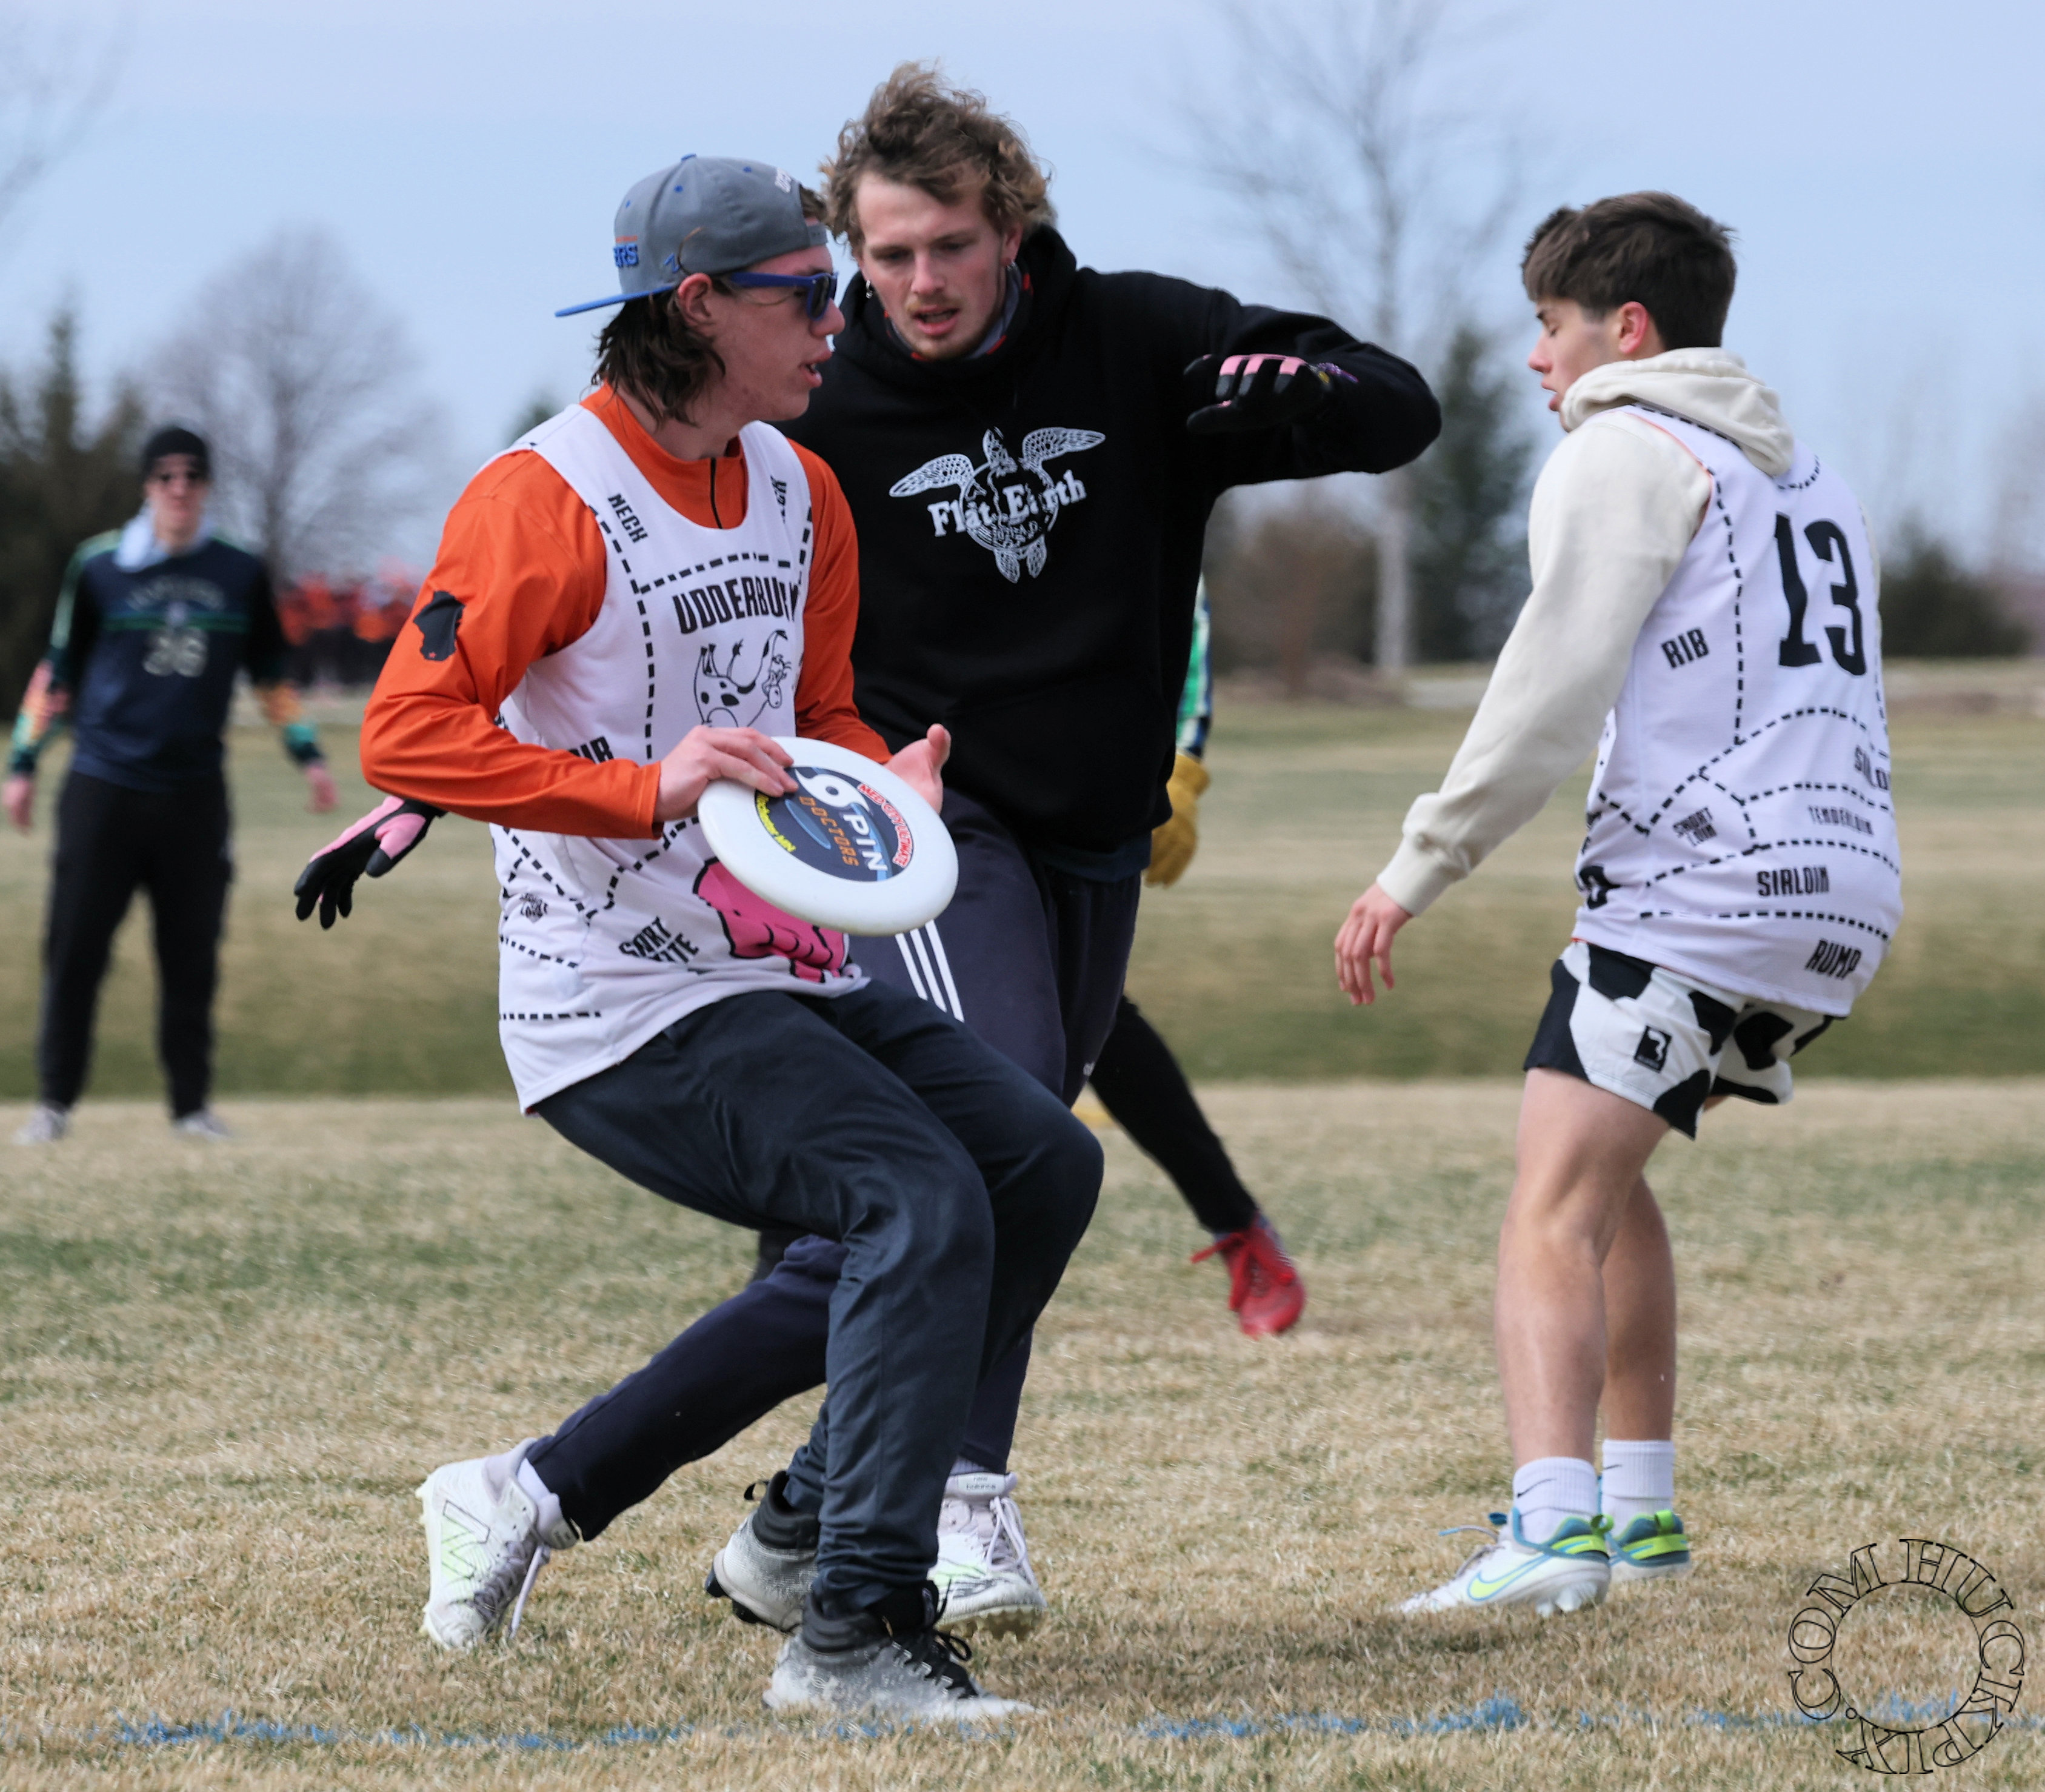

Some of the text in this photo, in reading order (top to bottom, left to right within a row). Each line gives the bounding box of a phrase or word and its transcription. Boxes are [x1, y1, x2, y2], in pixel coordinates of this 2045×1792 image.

[608, 493, 647, 543] NECK
[927, 500, 993, 537] Flat
[1774, 511, 1867, 677] 13
[1661, 627, 1709, 669] RIB
[569, 736, 615, 764] IB
[798, 796, 859, 866] DOCTORS
[858, 784, 886, 805] MED
[892, 824, 913, 868] ULTIMATE
[1756, 866, 1829, 897] SIRLOIN
[1804, 939, 1863, 980] RUMP
